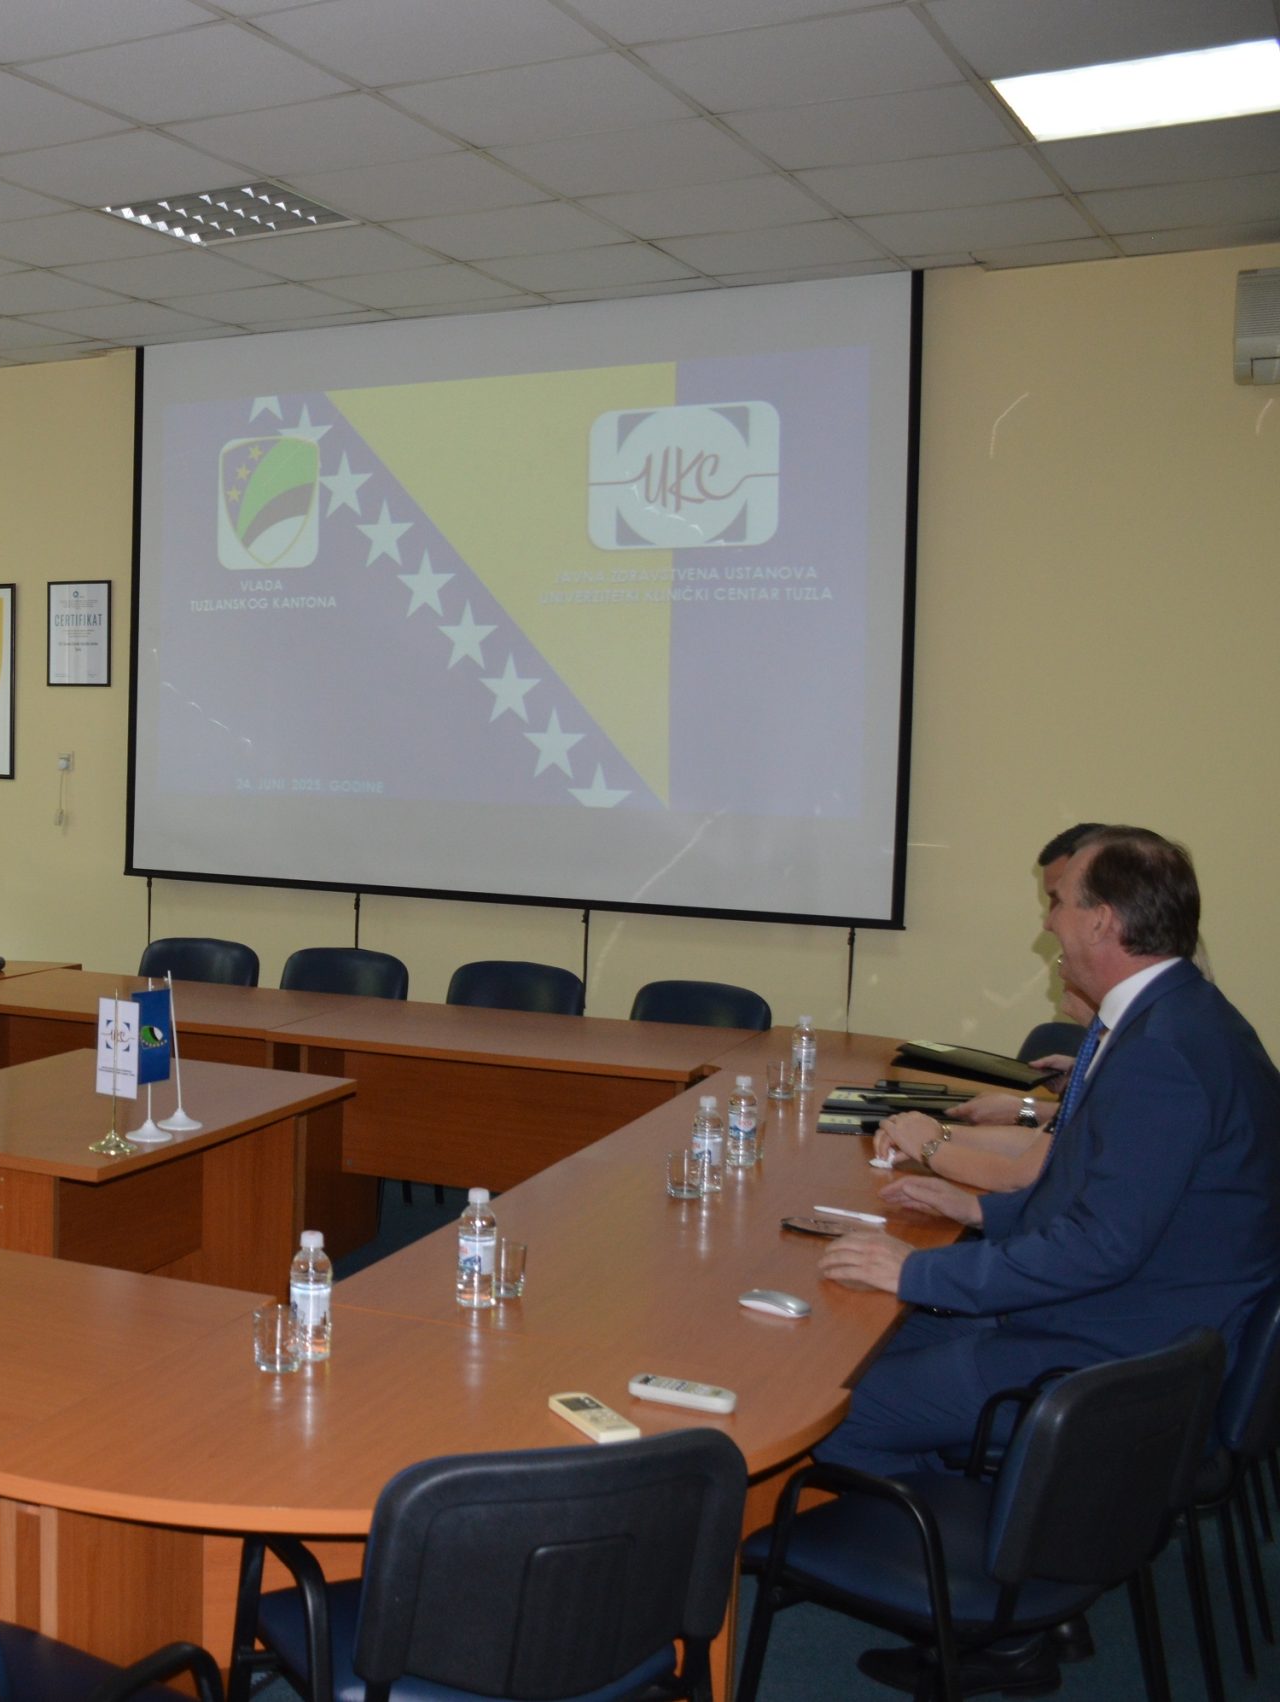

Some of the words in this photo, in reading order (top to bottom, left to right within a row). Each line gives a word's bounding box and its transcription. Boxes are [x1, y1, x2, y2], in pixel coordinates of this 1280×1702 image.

[641, 446, 721, 513] UKC
[723, 565, 818, 580] USTANOVA
[240, 579, 283, 592] VLADA
[713, 586, 781, 601] CENTAR
[783, 585, 834, 601] TUZLA
[191, 597, 269, 611] TUZLANSKOG
[272, 596, 337, 609] KANTONA
[54, 613, 102, 627] CERTIFIKAT
